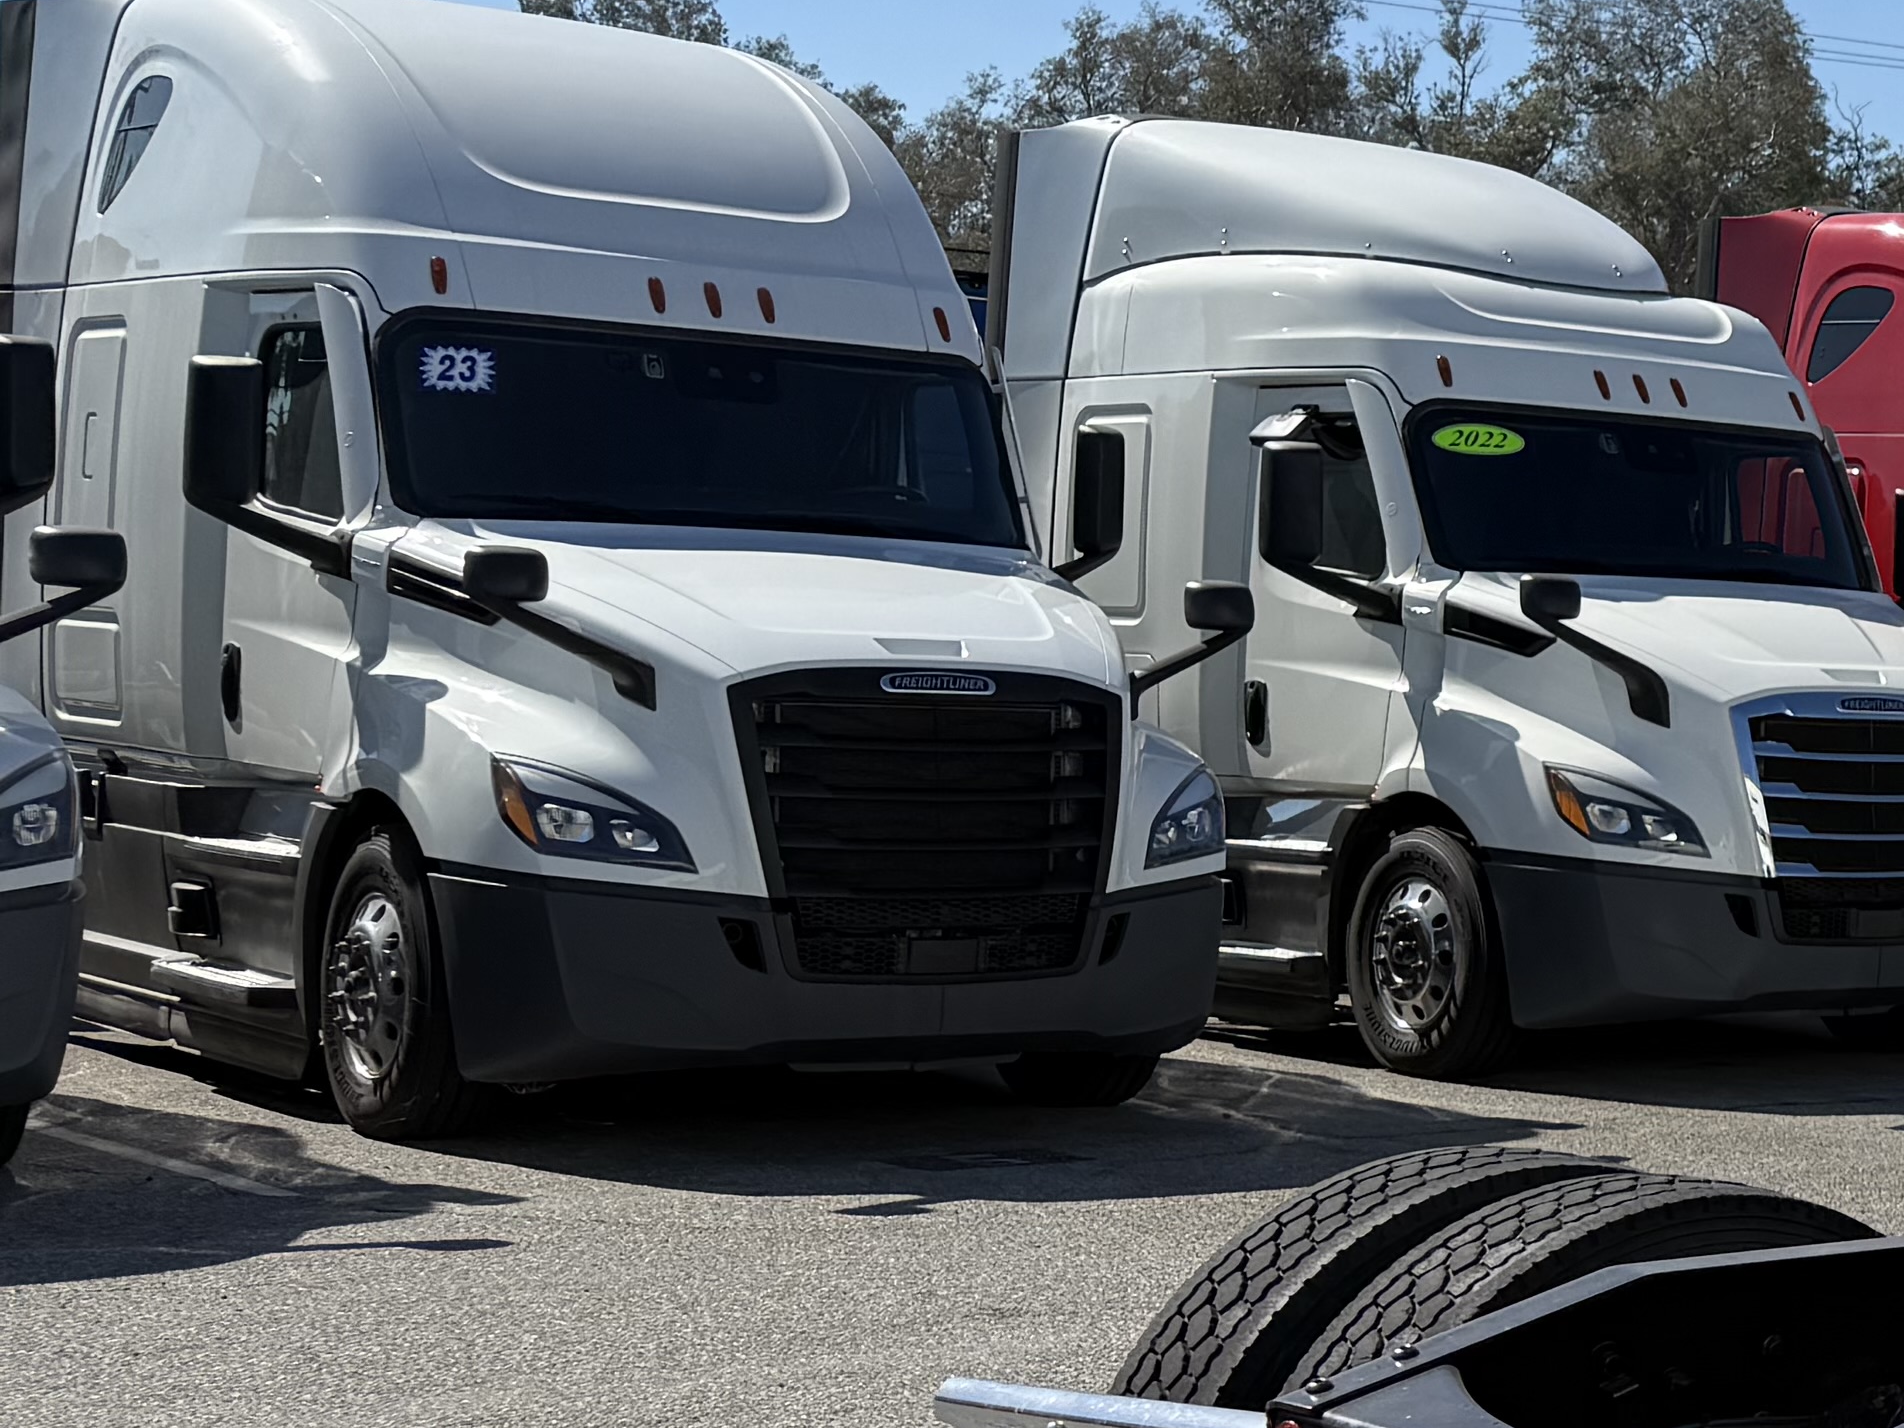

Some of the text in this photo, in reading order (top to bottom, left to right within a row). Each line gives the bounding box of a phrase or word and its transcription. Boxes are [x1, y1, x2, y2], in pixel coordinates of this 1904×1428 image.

[437, 354, 477, 382] 23
[1448, 429, 1508, 449] 2022
[894, 676, 985, 690] FREIGHTLINER
